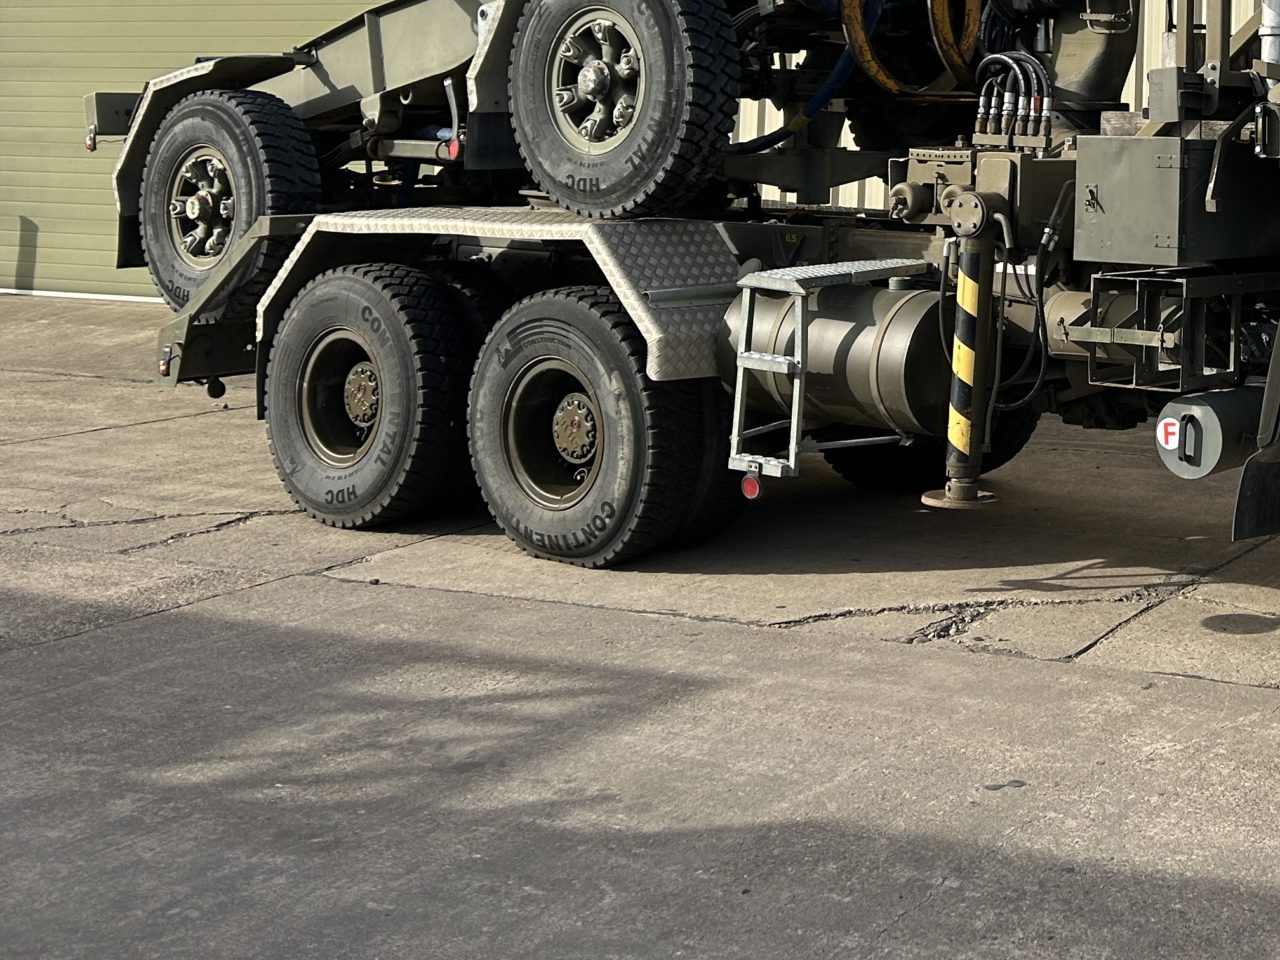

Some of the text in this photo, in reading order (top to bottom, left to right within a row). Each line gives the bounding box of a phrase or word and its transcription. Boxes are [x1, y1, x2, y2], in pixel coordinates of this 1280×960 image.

[1163, 422, 1177, 446] F
[325, 484, 358, 506] HDC
[503, 500, 617, 552] CONTINENT
